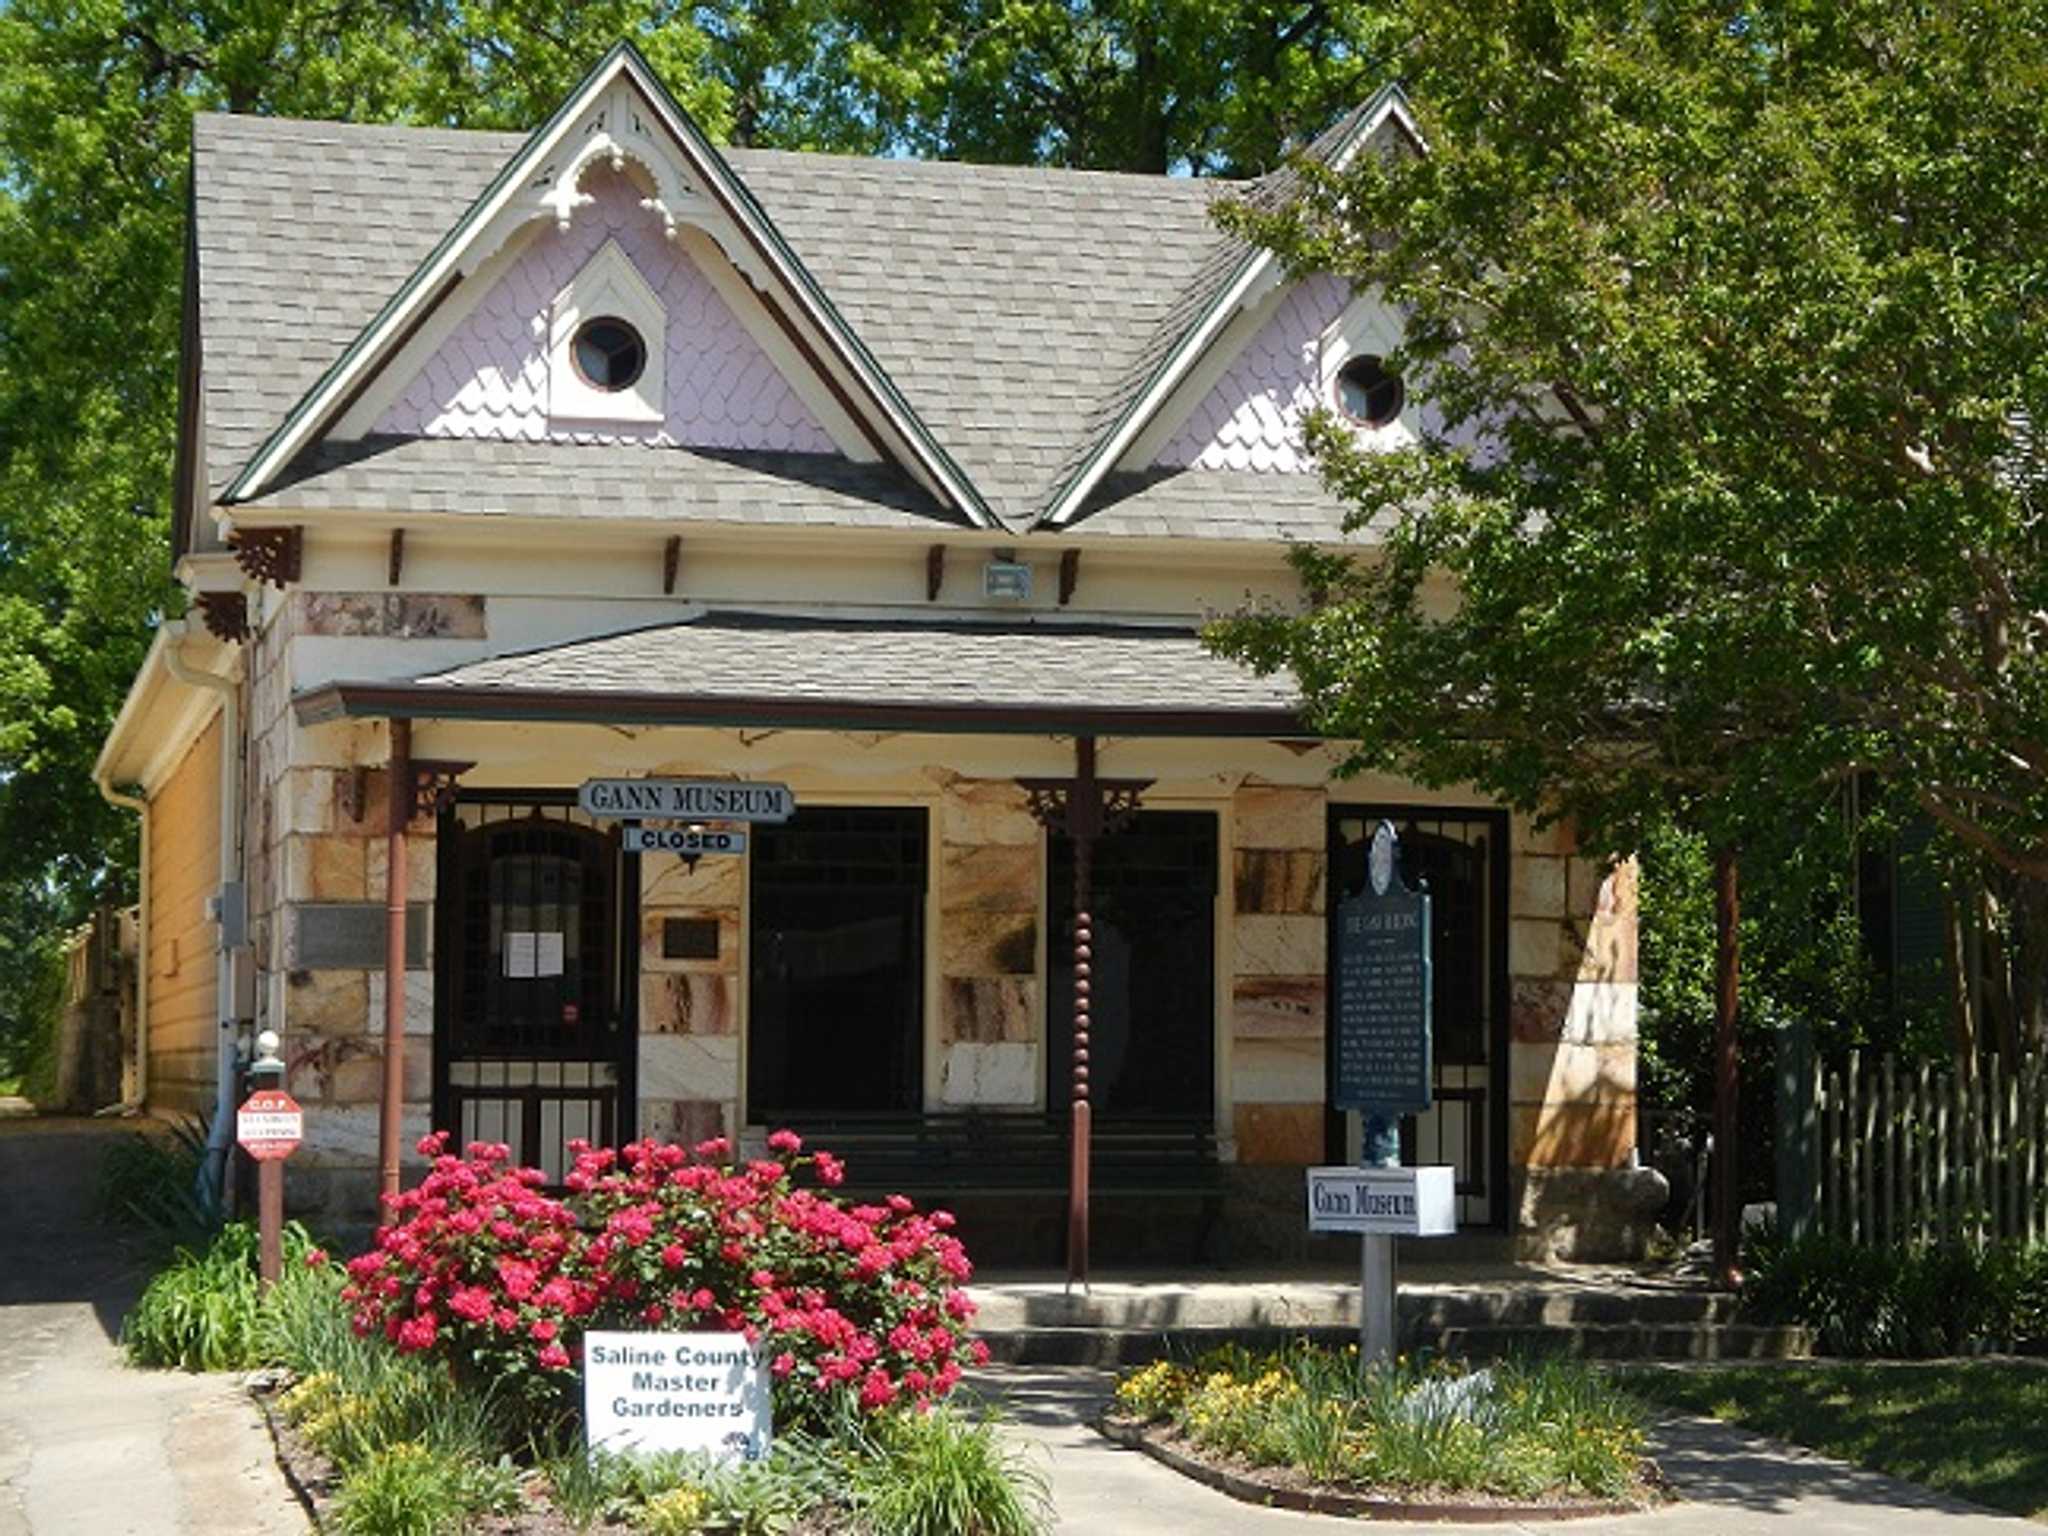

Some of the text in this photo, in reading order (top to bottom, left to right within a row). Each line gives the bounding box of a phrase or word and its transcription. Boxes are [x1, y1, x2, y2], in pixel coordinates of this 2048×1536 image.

[590, 784, 783, 814] GANN MUSEUM
[640, 830, 731, 849] CLOSED
[1354, 1184, 1417, 1215] Museum
[591, 1346, 762, 1369] Saline County
[632, 1372, 720, 1392] Master
[612, 1397, 744, 1418] Gardeners
